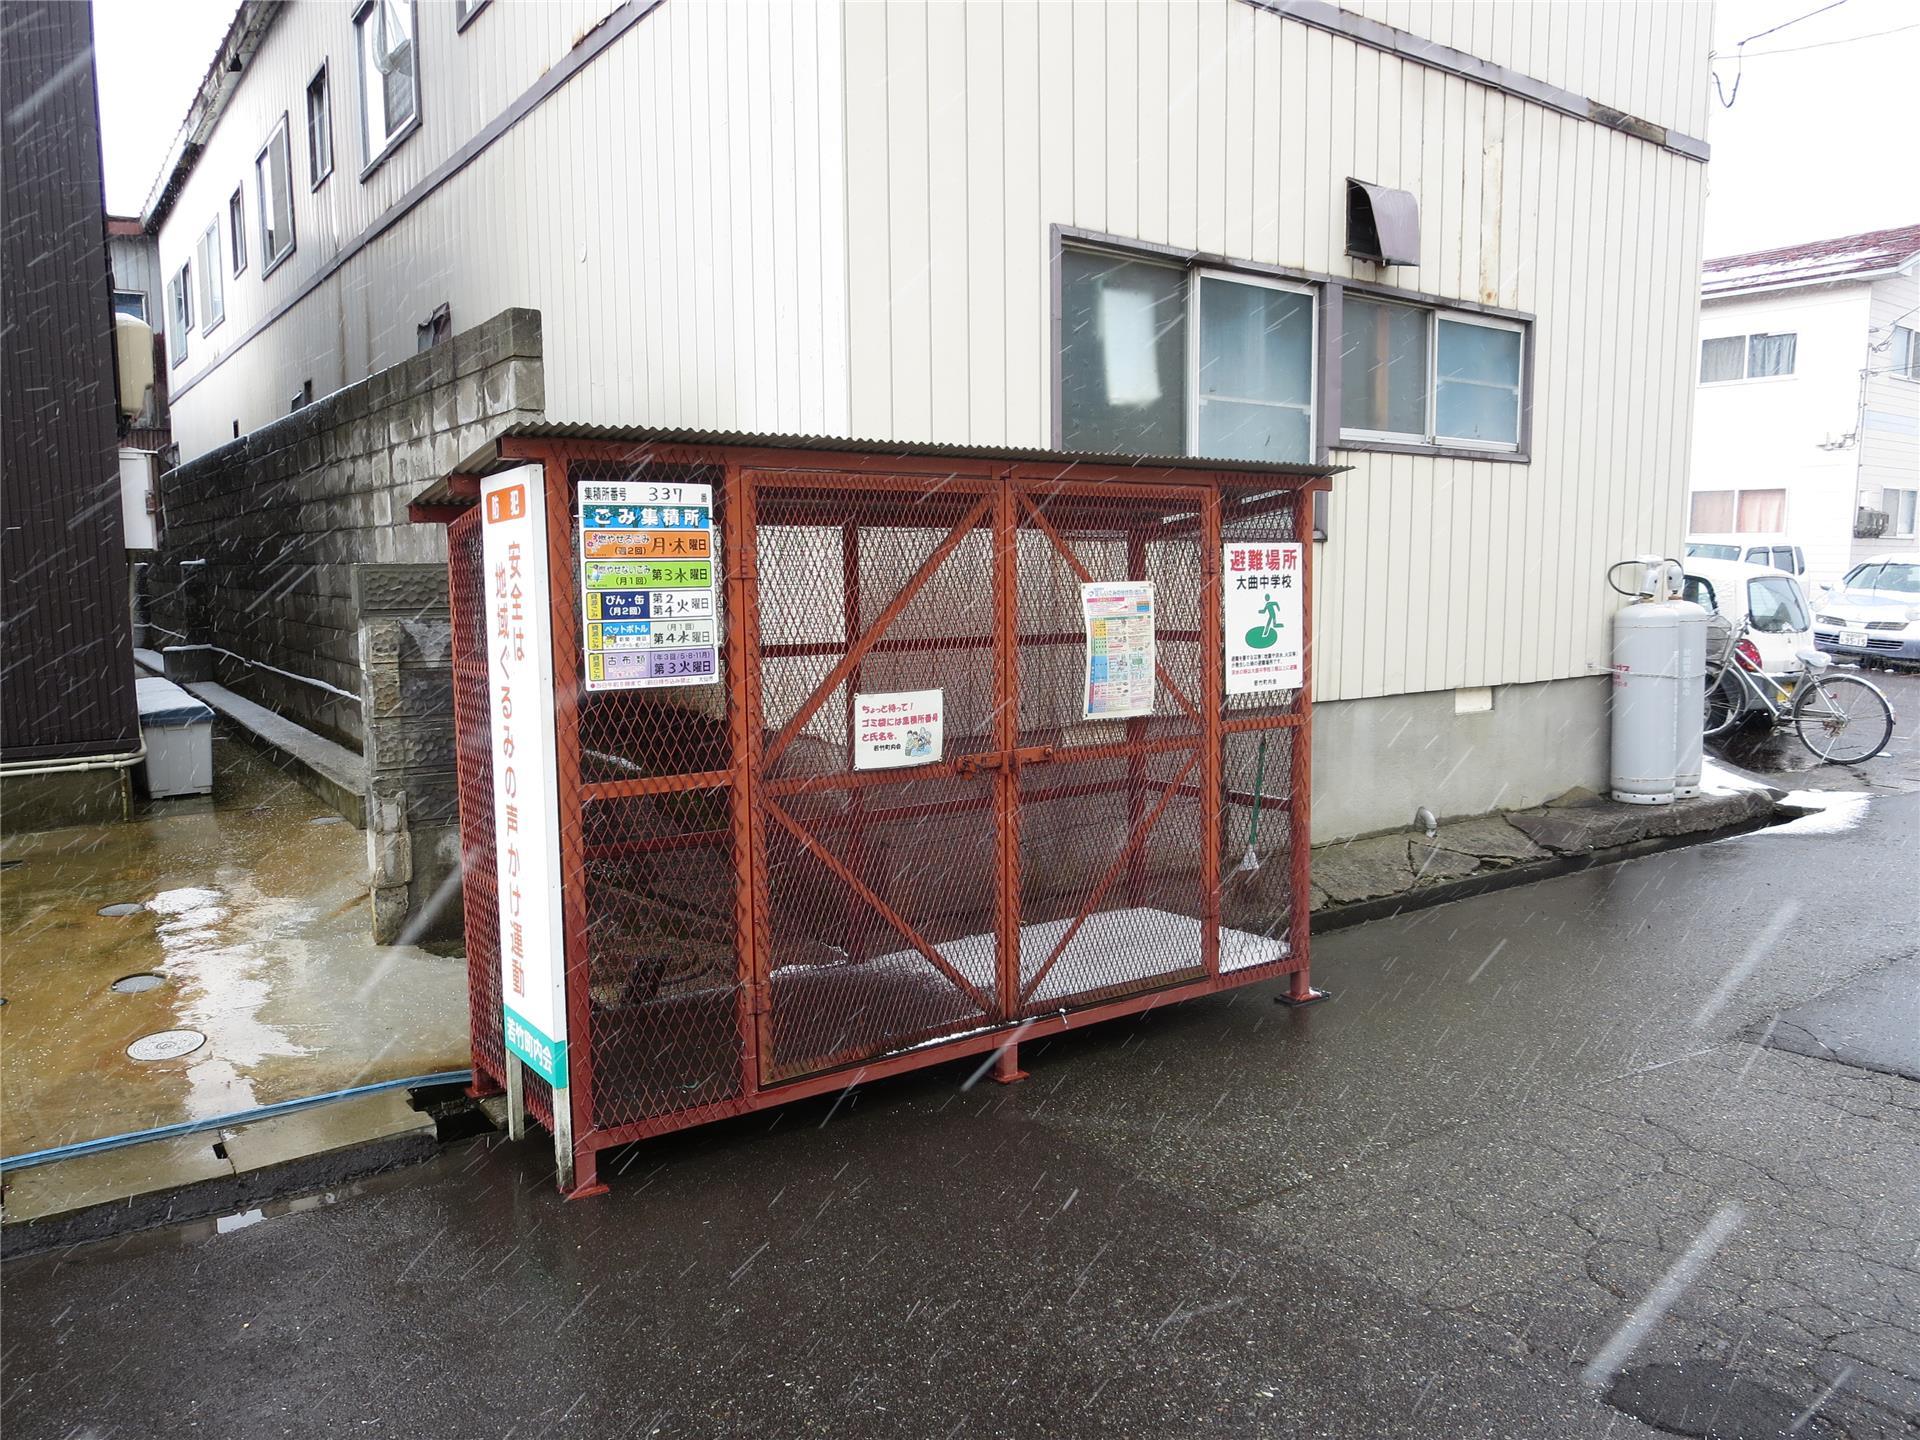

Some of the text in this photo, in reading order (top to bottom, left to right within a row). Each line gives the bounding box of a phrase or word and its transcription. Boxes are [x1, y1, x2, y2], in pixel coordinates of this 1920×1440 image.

[491, 489, 520, 513] 防犯
[584, 486, 627, 502] 集積所番号
[648, 486, 683, 503] 337
[594, 507, 700, 527] ごみ集積所
[651, 536, 707, 555] 月・木曜日
[1230, 549, 1298, 572] 避難場所
[616, 576, 648, 586] (月1回)
[652, 567, 707, 583] 第3水曜日
[1236, 574, 1292, 591] 大曲中学校
[507, 539, 526, 663] 安全は
[605, 594, 645, 606] びん・缶
[653, 593, 674, 604] 第2
[677, 598, 709, 614] 火曜日
[609, 606, 642, 617] (月2回)
[653, 605, 674, 618] 第4
[604, 624, 649, 635] ペットボトル
[653, 630, 710, 645] 第4水曜日
[654, 660, 711, 675] 第3火曜日
[494, 560, 525, 999] 地域ぐるみの声かけ運動
